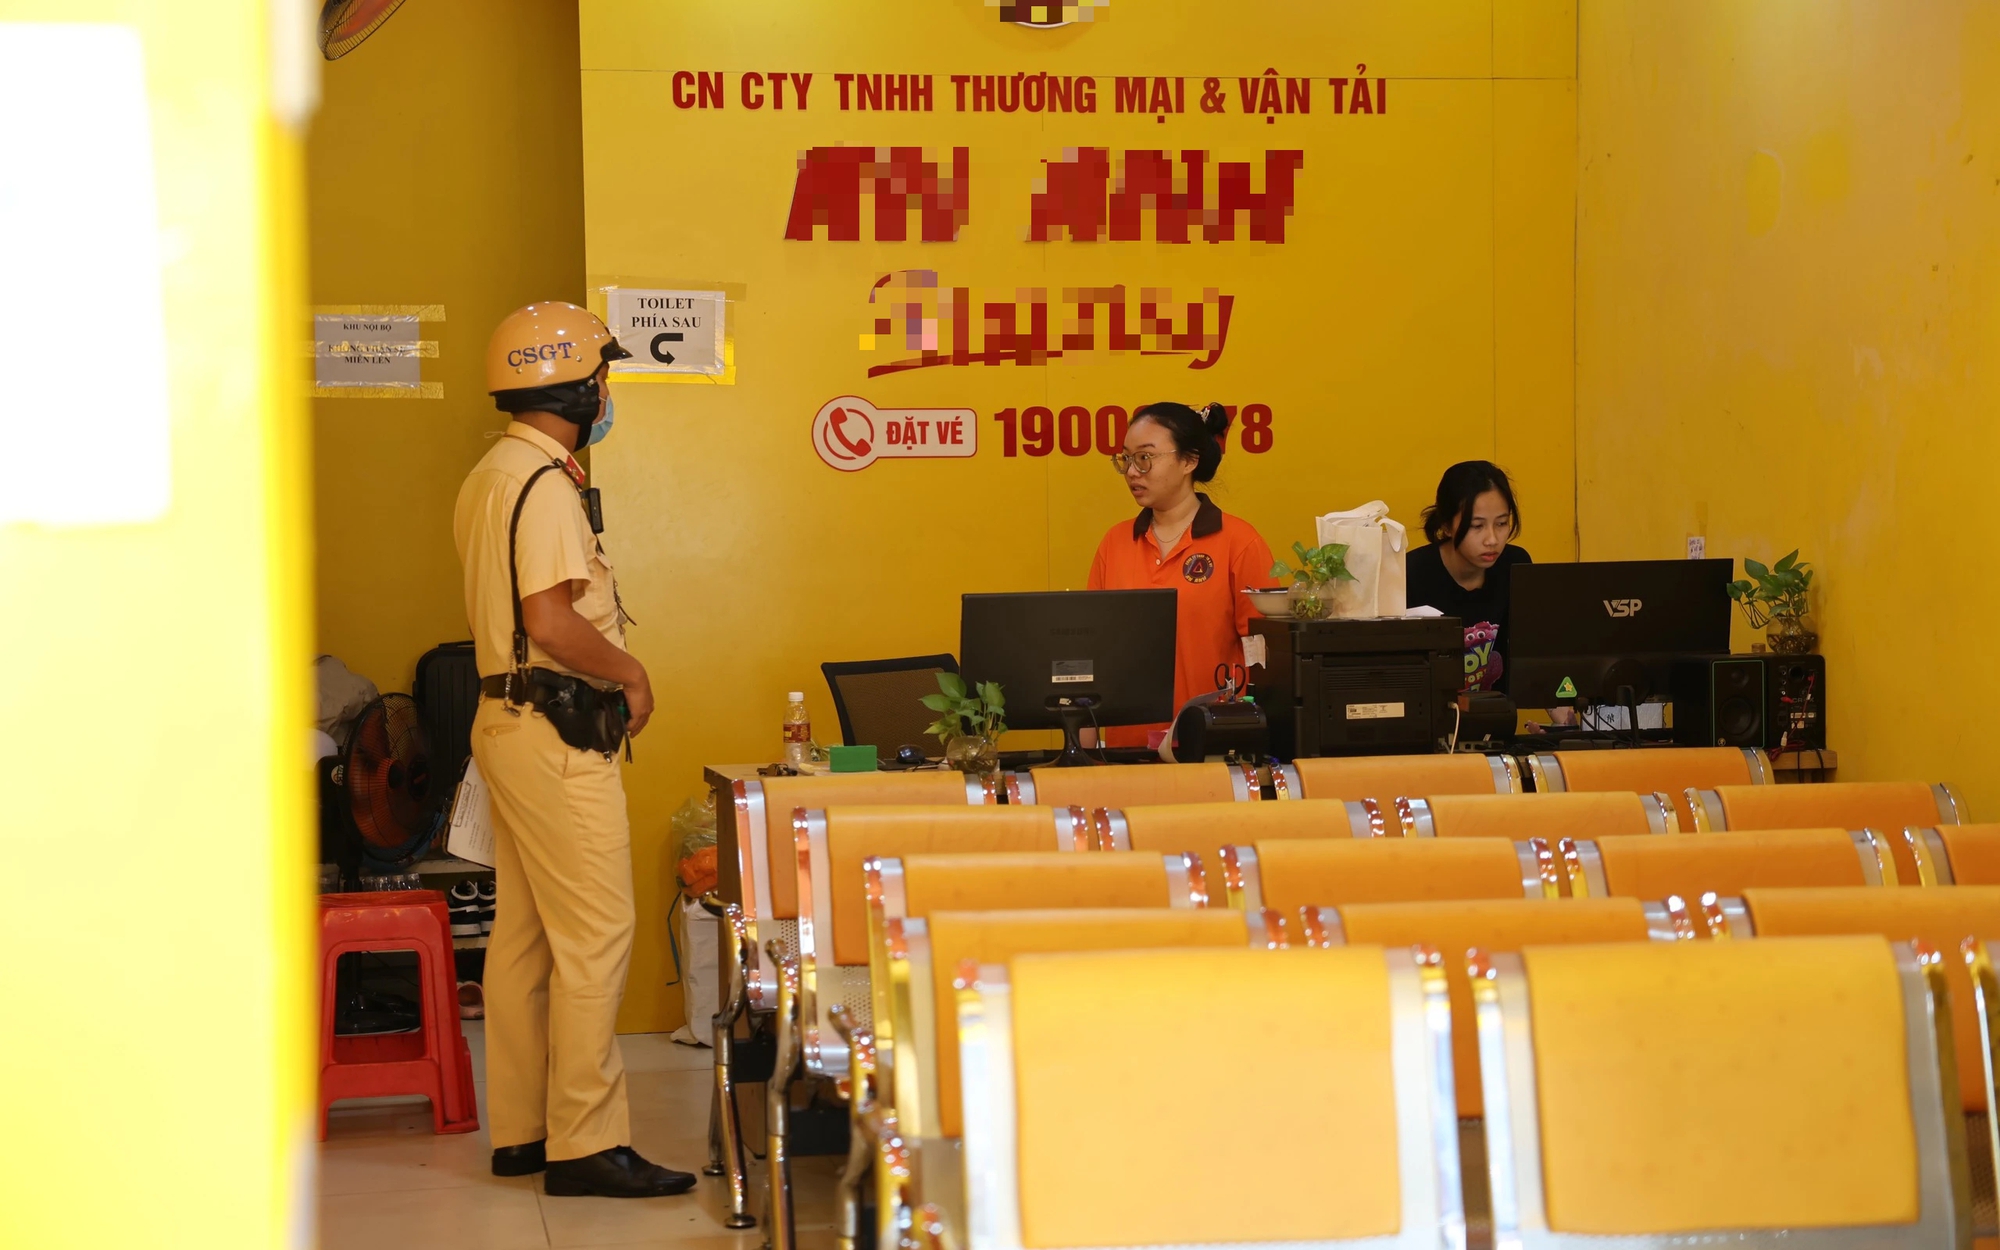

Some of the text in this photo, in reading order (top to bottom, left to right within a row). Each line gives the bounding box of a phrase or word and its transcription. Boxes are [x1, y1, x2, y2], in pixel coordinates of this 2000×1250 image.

[672, 63, 1386, 124] CN CTY TNHH THƯƠNG MẠI & VẬN TẢI
[637, 297, 695, 309] TOILET
[343, 323, 361, 331] KHU
[631, 313, 702, 328] PHÍA SAU
[507, 341, 572, 368] CSGT
[886, 403, 1274, 458] ĐẶT VÉ 190078
[1602, 599, 1643, 618] VSP
[1464, 641, 1493, 674] OY
